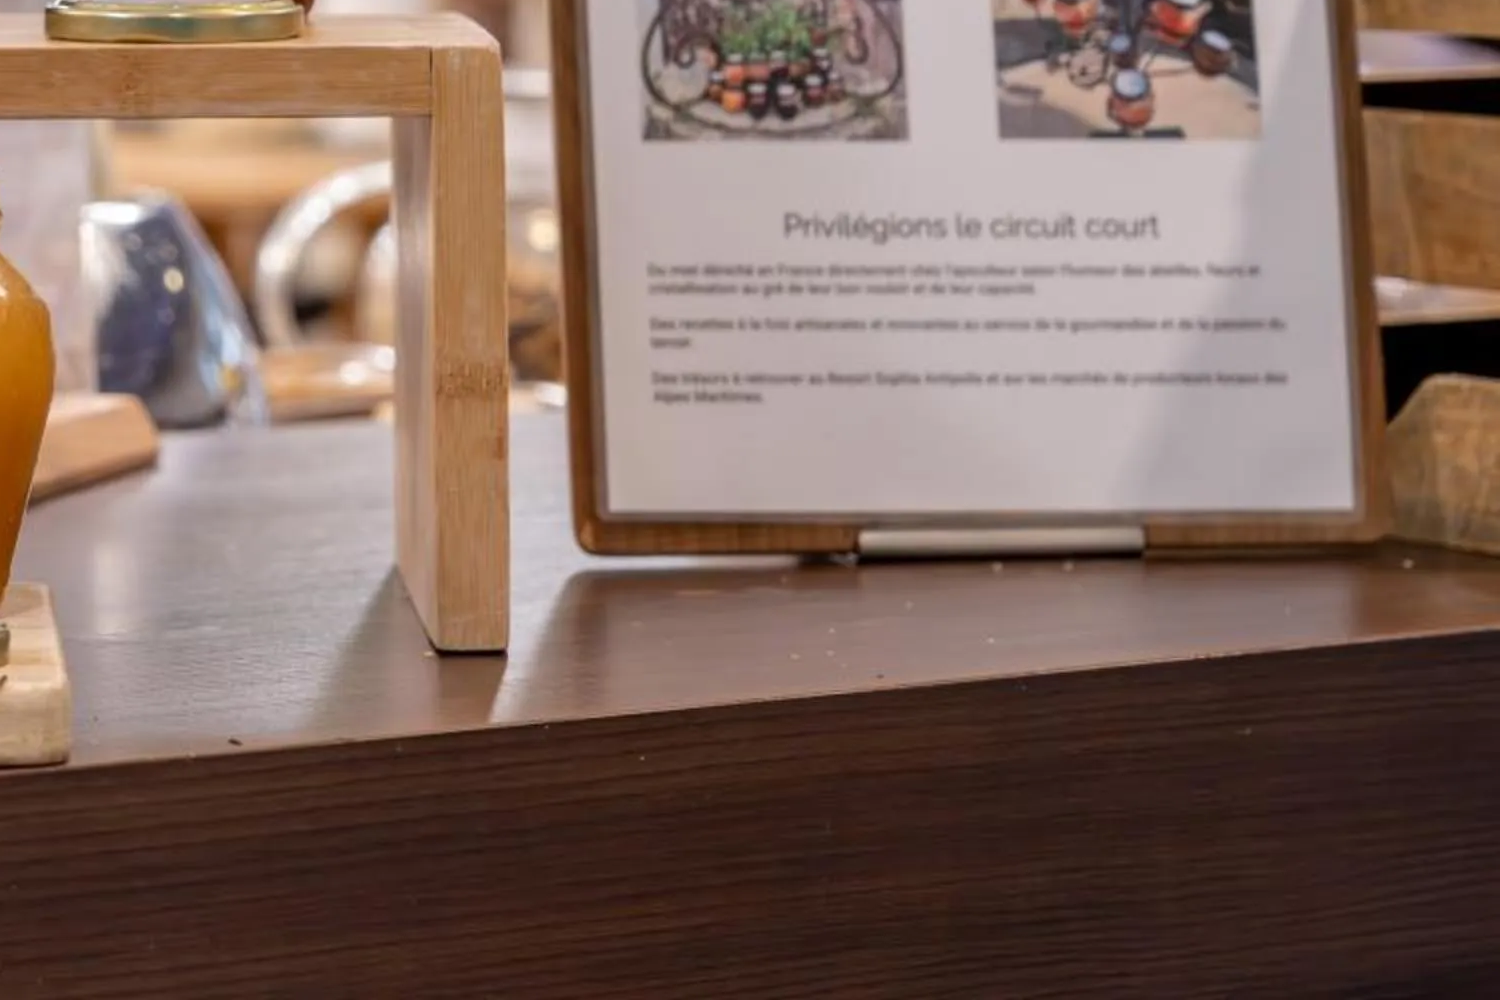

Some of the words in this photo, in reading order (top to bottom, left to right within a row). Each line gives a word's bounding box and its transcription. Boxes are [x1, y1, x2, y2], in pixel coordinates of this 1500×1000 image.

[783, 211, 948, 244] Privilégions
[956, 213, 981, 239] le
[989, 213, 1076, 240] circuit
[1085, 215, 1161, 240] court
